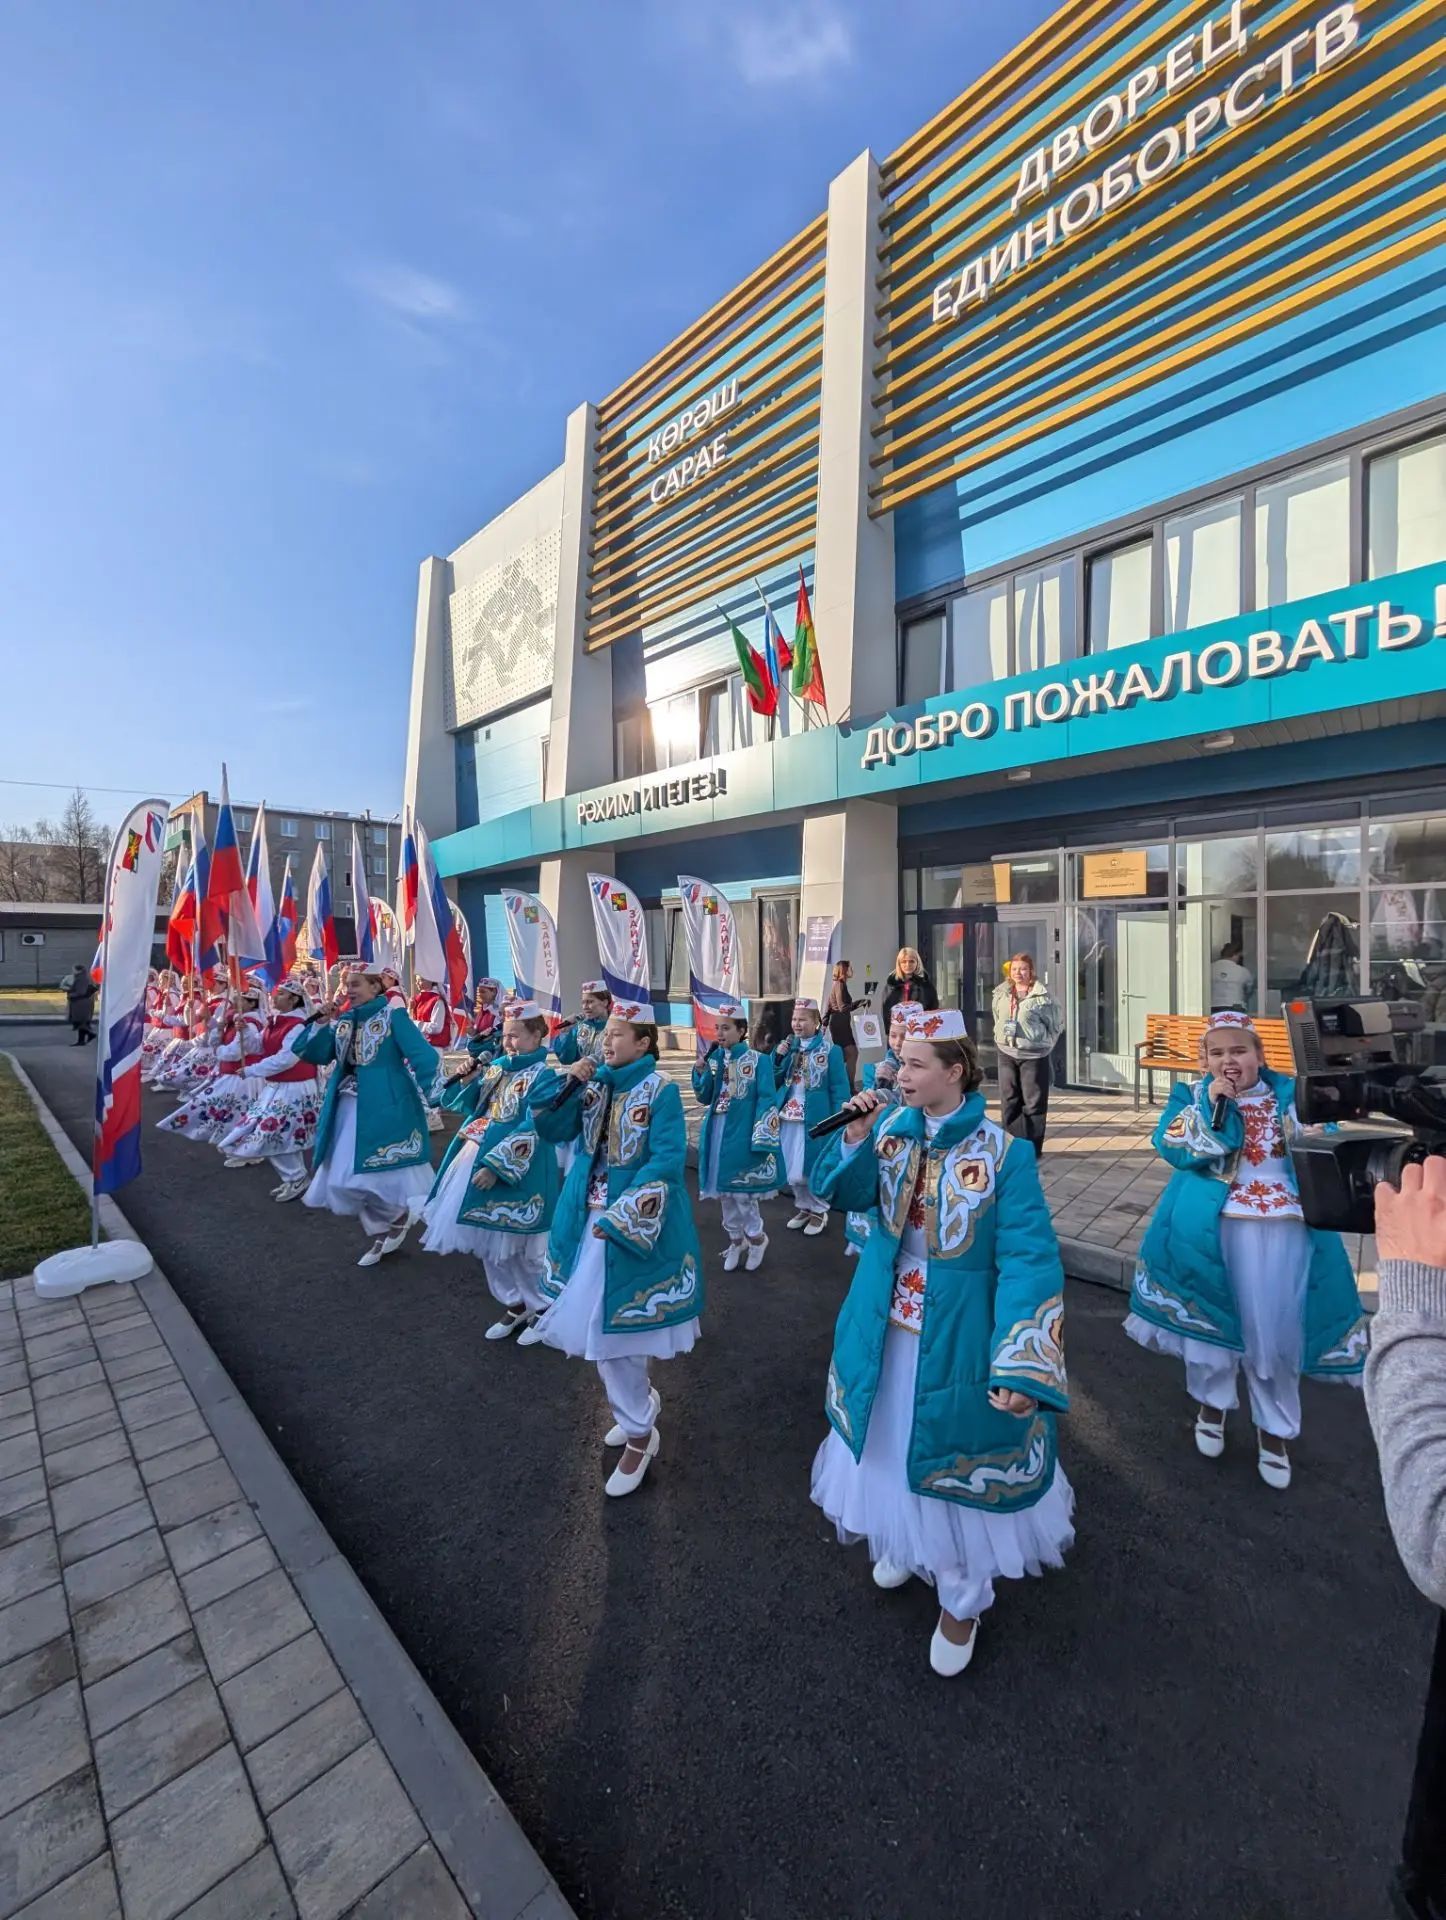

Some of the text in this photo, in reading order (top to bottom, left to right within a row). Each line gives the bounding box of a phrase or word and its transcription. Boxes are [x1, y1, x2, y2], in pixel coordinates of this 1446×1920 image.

[1012, 0, 1247, 215] ДВОРЕЦ
[932, 3, 1360, 323] ЕДИНОБОРСТВ
[648, 378, 738, 463] КӨРӘШ
[651, 432, 729, 503] САРАЕ
[861, 702, 992, 769] ДОБРО
[577, 789, 640, 825] РӘХИМ
[541, 921, 555, 977] ЗАИНСК
[629, 909, 641, 968] ЗАИНСК
[720, 913, 731, 976] ЗАИНСК
